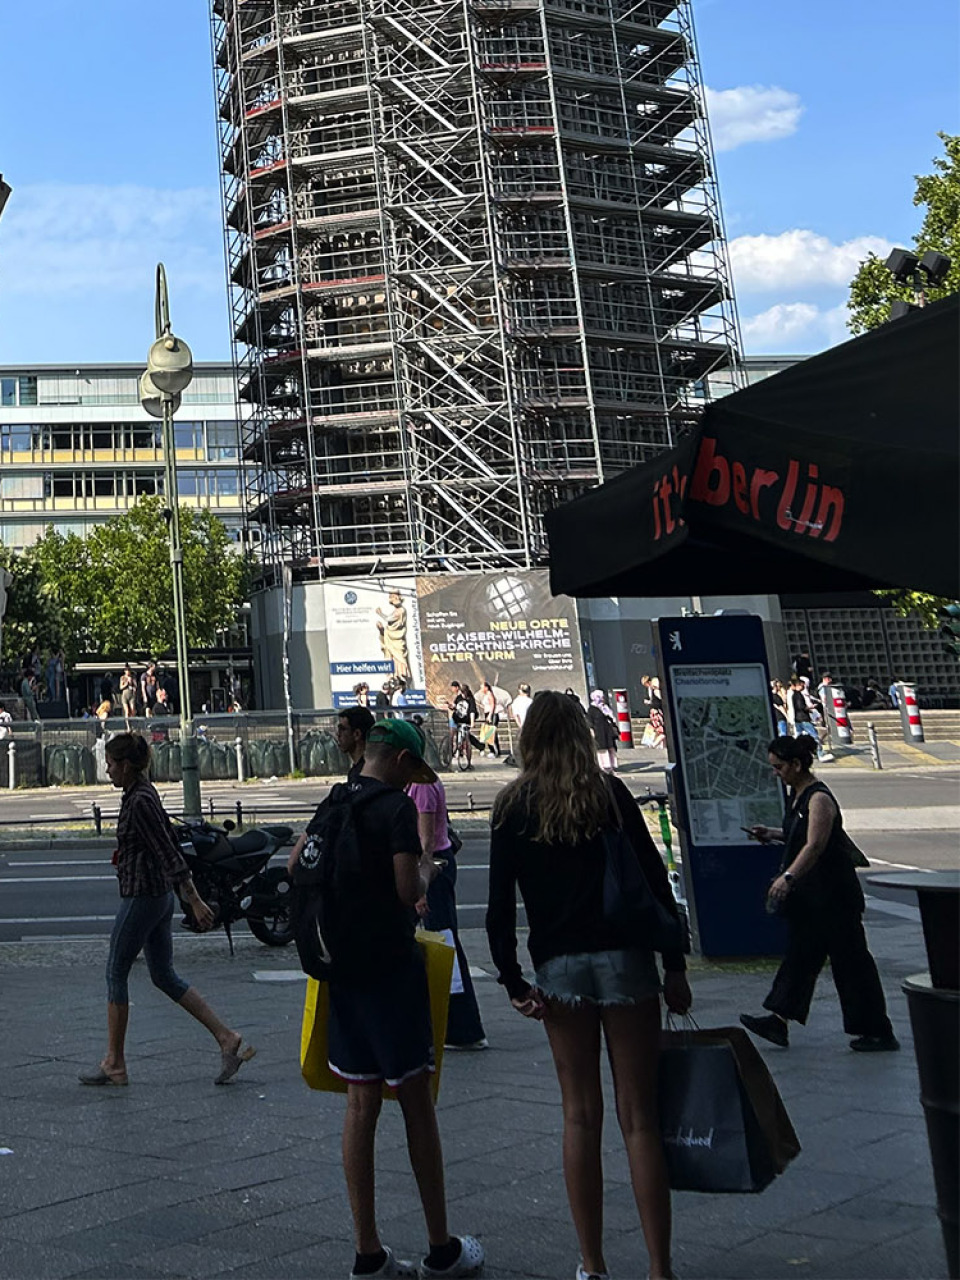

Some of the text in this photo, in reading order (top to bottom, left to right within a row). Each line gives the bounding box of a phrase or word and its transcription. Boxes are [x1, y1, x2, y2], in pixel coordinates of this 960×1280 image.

[691, 436, 846, 542] berlin
[490, 618, 569, 631] NEUE ORTE
[446, 629, 570, 642] KAISER-WILHELM-
[429, 638, 572, 653] GEDÄCHTNIS-KIRCHE
[431, 650, 516, 663] ALTER TURM
[336, 663, 392, 673] Hier helfen wir!
